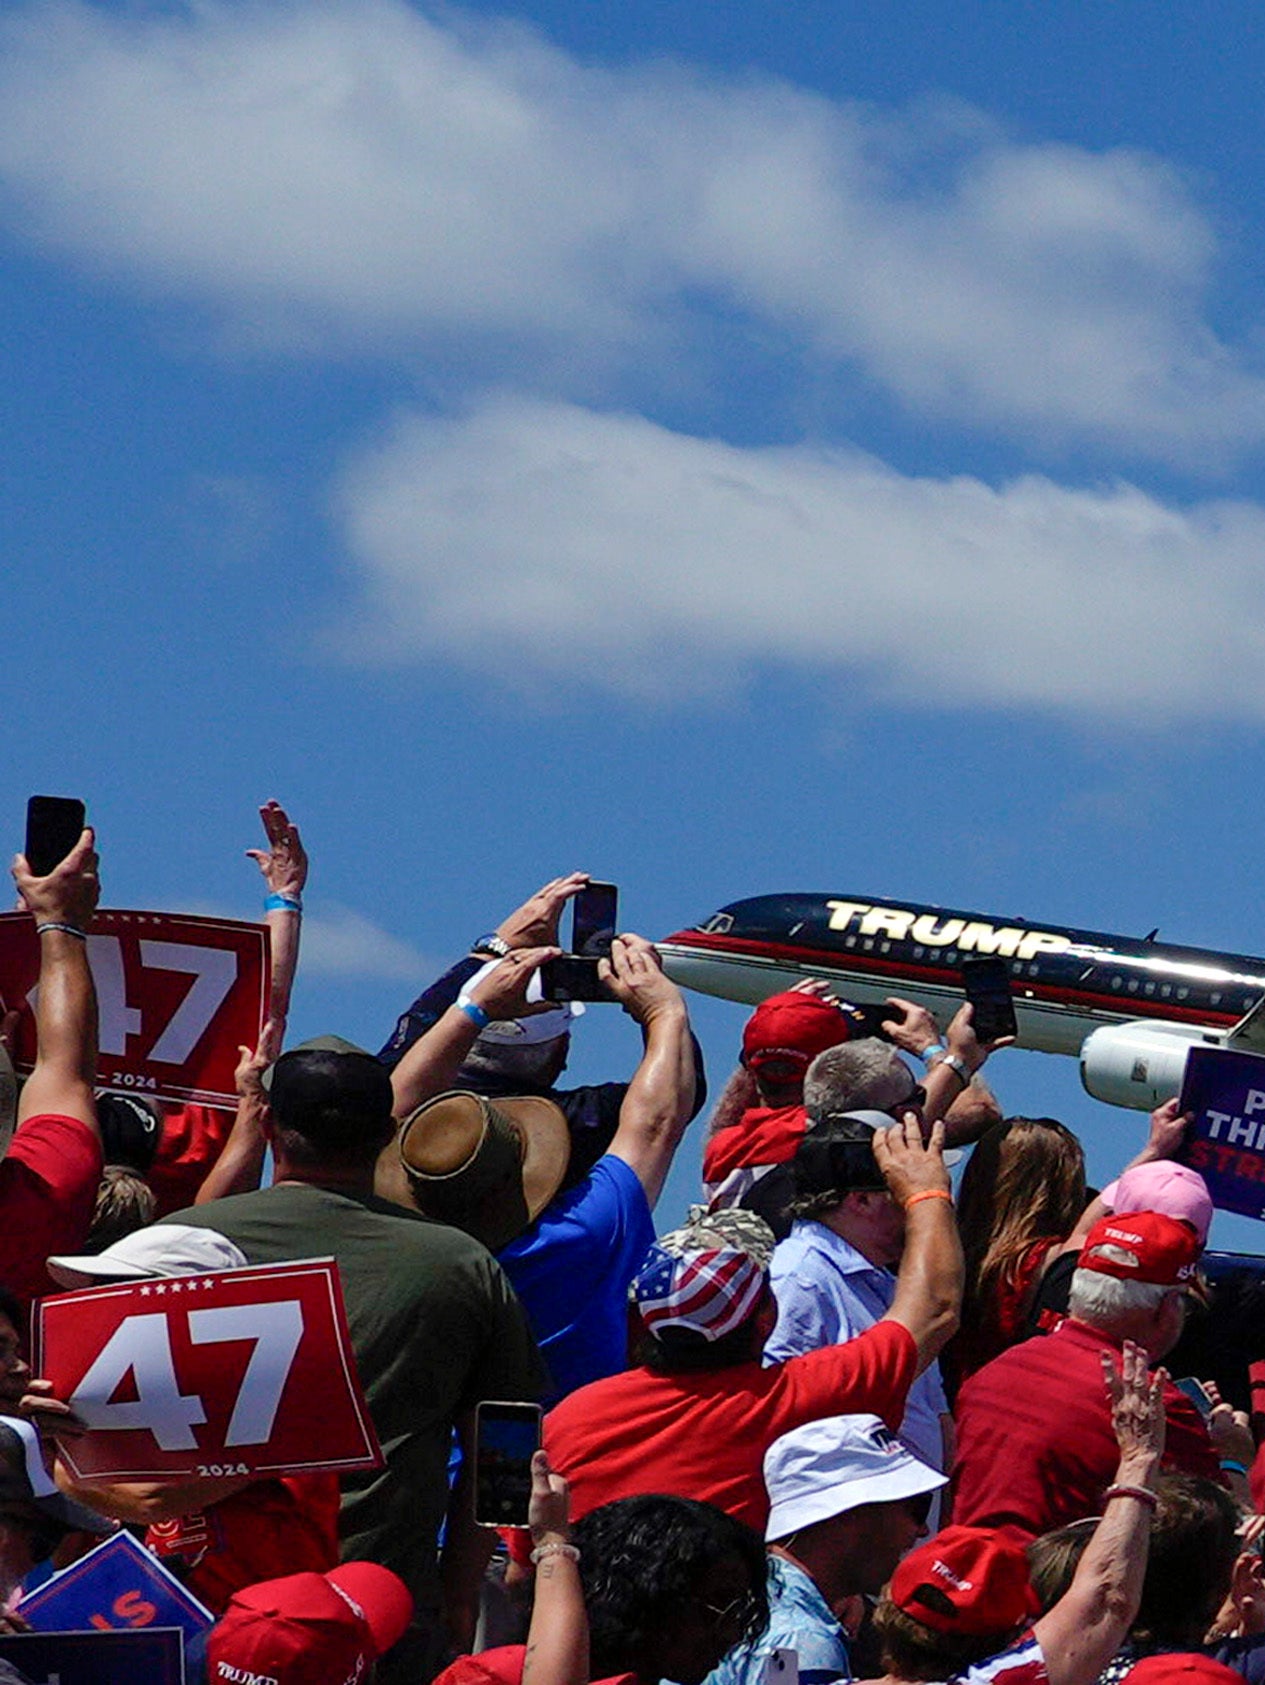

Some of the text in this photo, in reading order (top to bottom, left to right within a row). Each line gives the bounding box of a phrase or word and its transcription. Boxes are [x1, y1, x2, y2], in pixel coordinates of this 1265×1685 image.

[827, 900, 1072, 960] TRUMP
[112, 1071, 157, 1089] 2024
[1105, 1227, 1143, 1244] TRUMP
[68, 1300, 304, 1451] 47
[197, 1463, 250, 1477] 2024
[931, 1560, 973, 1591] TRUMP
